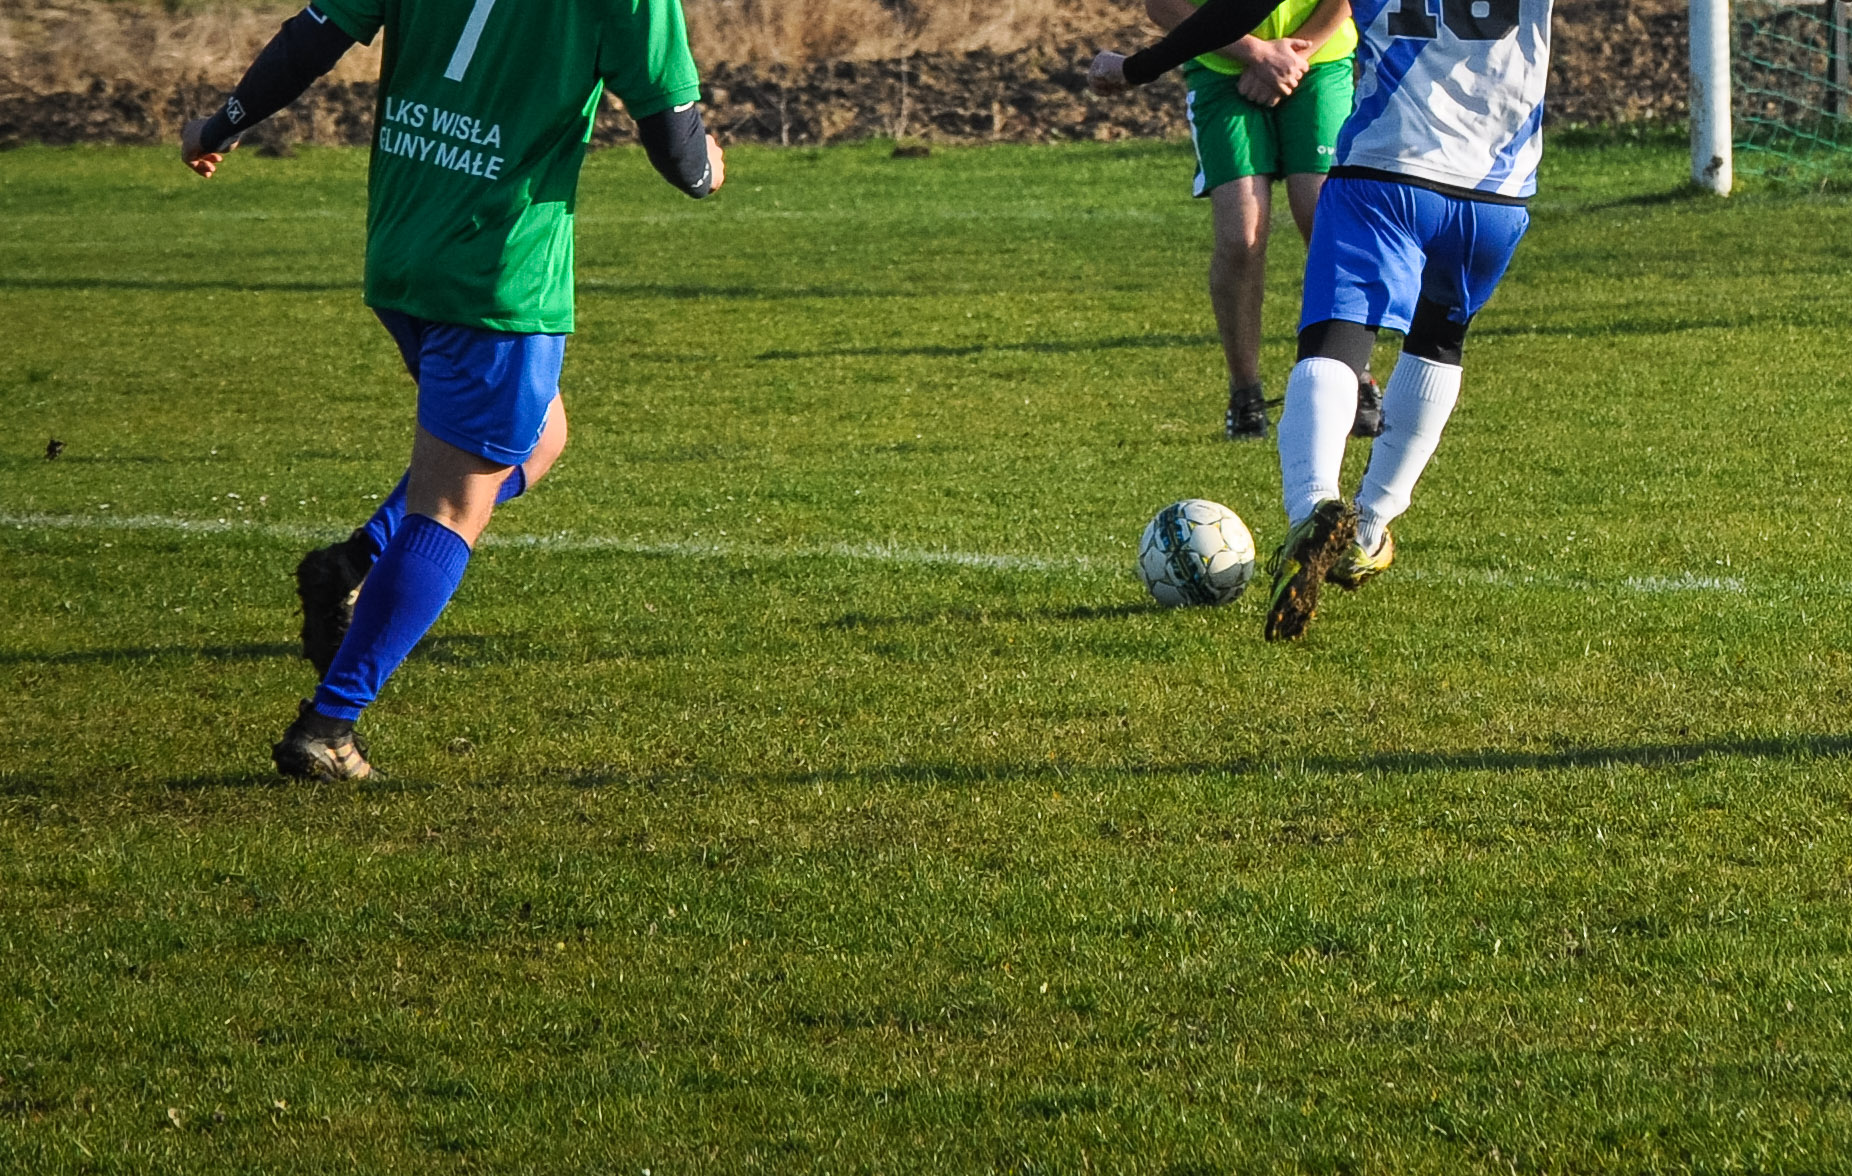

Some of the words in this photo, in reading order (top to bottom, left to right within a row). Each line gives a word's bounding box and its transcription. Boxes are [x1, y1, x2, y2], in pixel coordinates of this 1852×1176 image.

[386, 96, 428, 128] LKS
[432, 107, 501, 149] WISŁA
[434, 142, 505, 181] MAŁE
